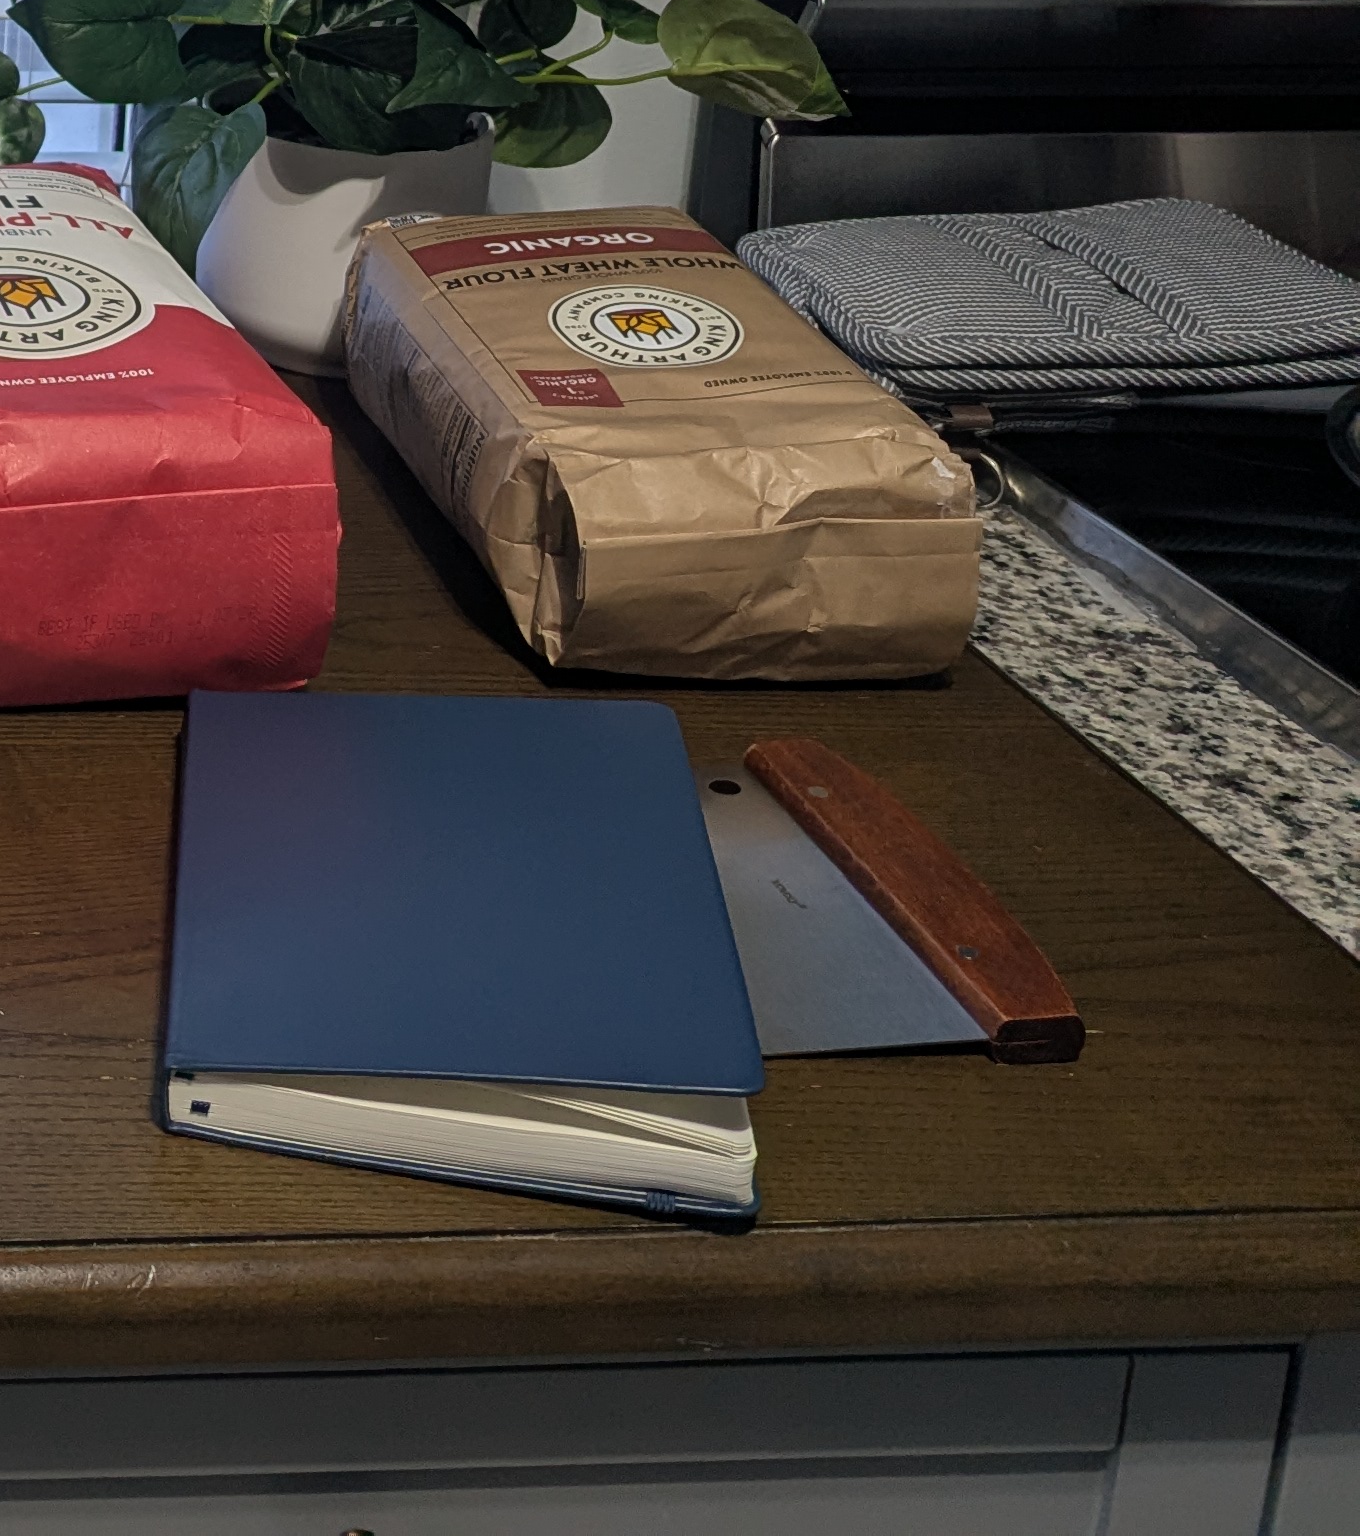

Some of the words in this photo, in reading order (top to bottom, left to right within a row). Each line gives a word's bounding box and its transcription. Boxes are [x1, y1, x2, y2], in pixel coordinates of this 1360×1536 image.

[483, 232, 655, 255] ORGANIC
[16, 255, 102, 284] BAKING
[542, 257, 637, 278] WHEAT
[640, 256, 745, 272] WHOLE
[442, 267, 537, 291] FLOUR
[567, 292, 625, 322] COMPANY
[634, 292, 704, 314] BAKING
[75, 297, 126, 333] KING
[576, 332, 688, 364] ARTHUR
[701, 324, 728, 357] KING
[39, 372, 116, 384] EMPLOYEE
[118, 367, 154, 378] 100%
[535, 376, 597, 387] ORGANIC
[703, 376, 748, 388] OWNED
